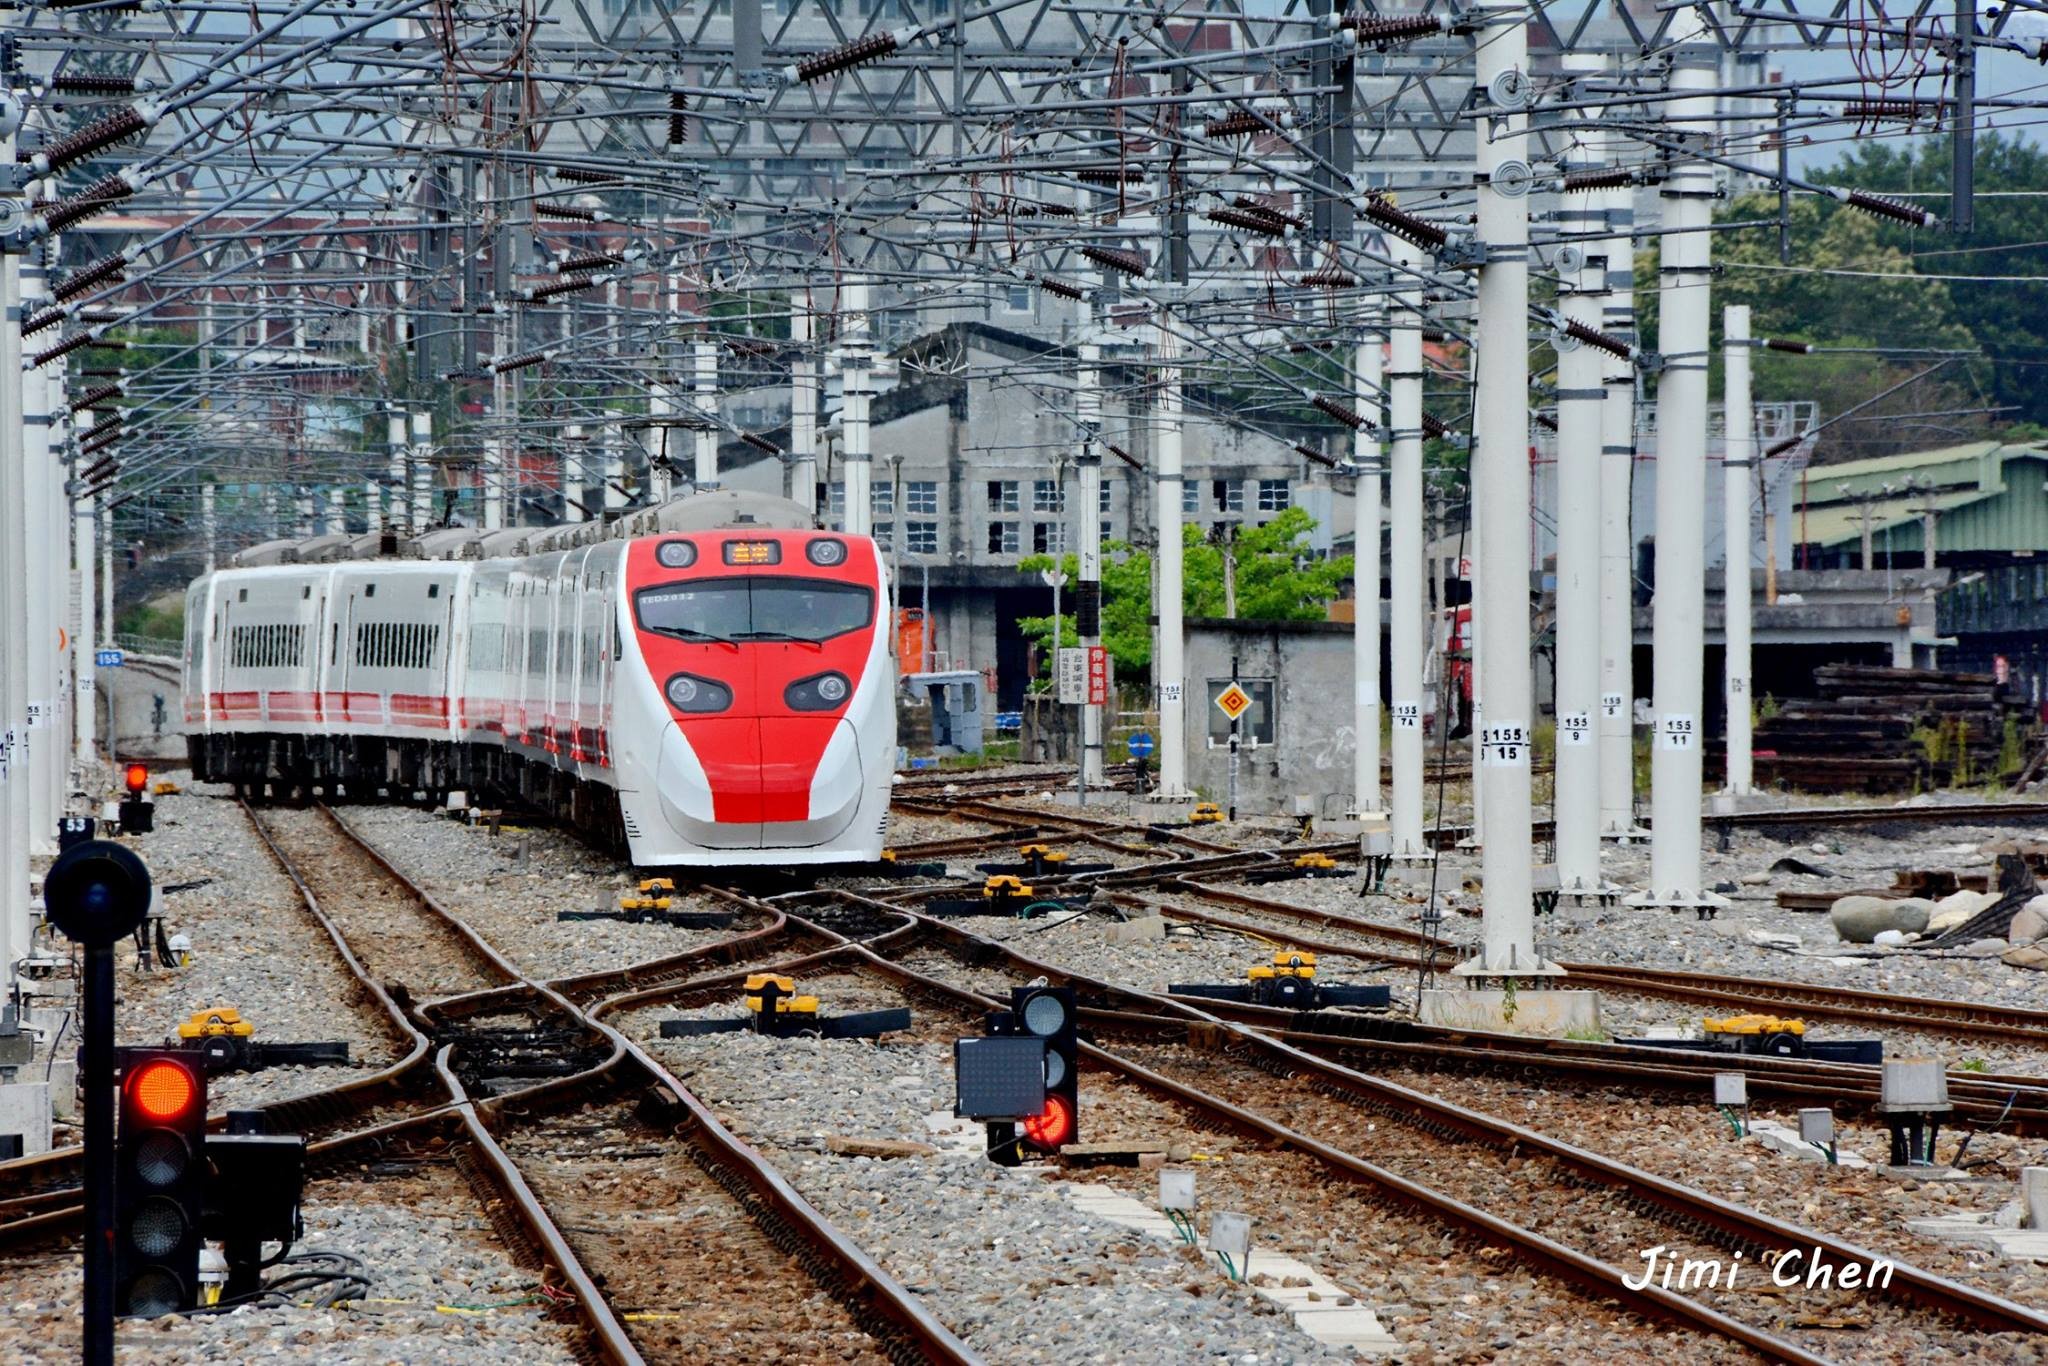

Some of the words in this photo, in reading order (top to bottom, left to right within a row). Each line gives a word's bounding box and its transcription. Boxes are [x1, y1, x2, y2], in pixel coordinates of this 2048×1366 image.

[99, 653, 119, 665] 155
[1399, 706, 1416, 714] 155
[1401, 718, 1413, 726] 7A
[1566, 718, 1587, 726] 155
[1668, 721, 1691, 730] 155
[1493, 729, 1521, 740] 155
[1573, 732, 1579, 740] 9
[1672, 735, 1687, 744] 11
[1499, 747, 1516, 759] 15
[67, 819, 85, 831] 53
